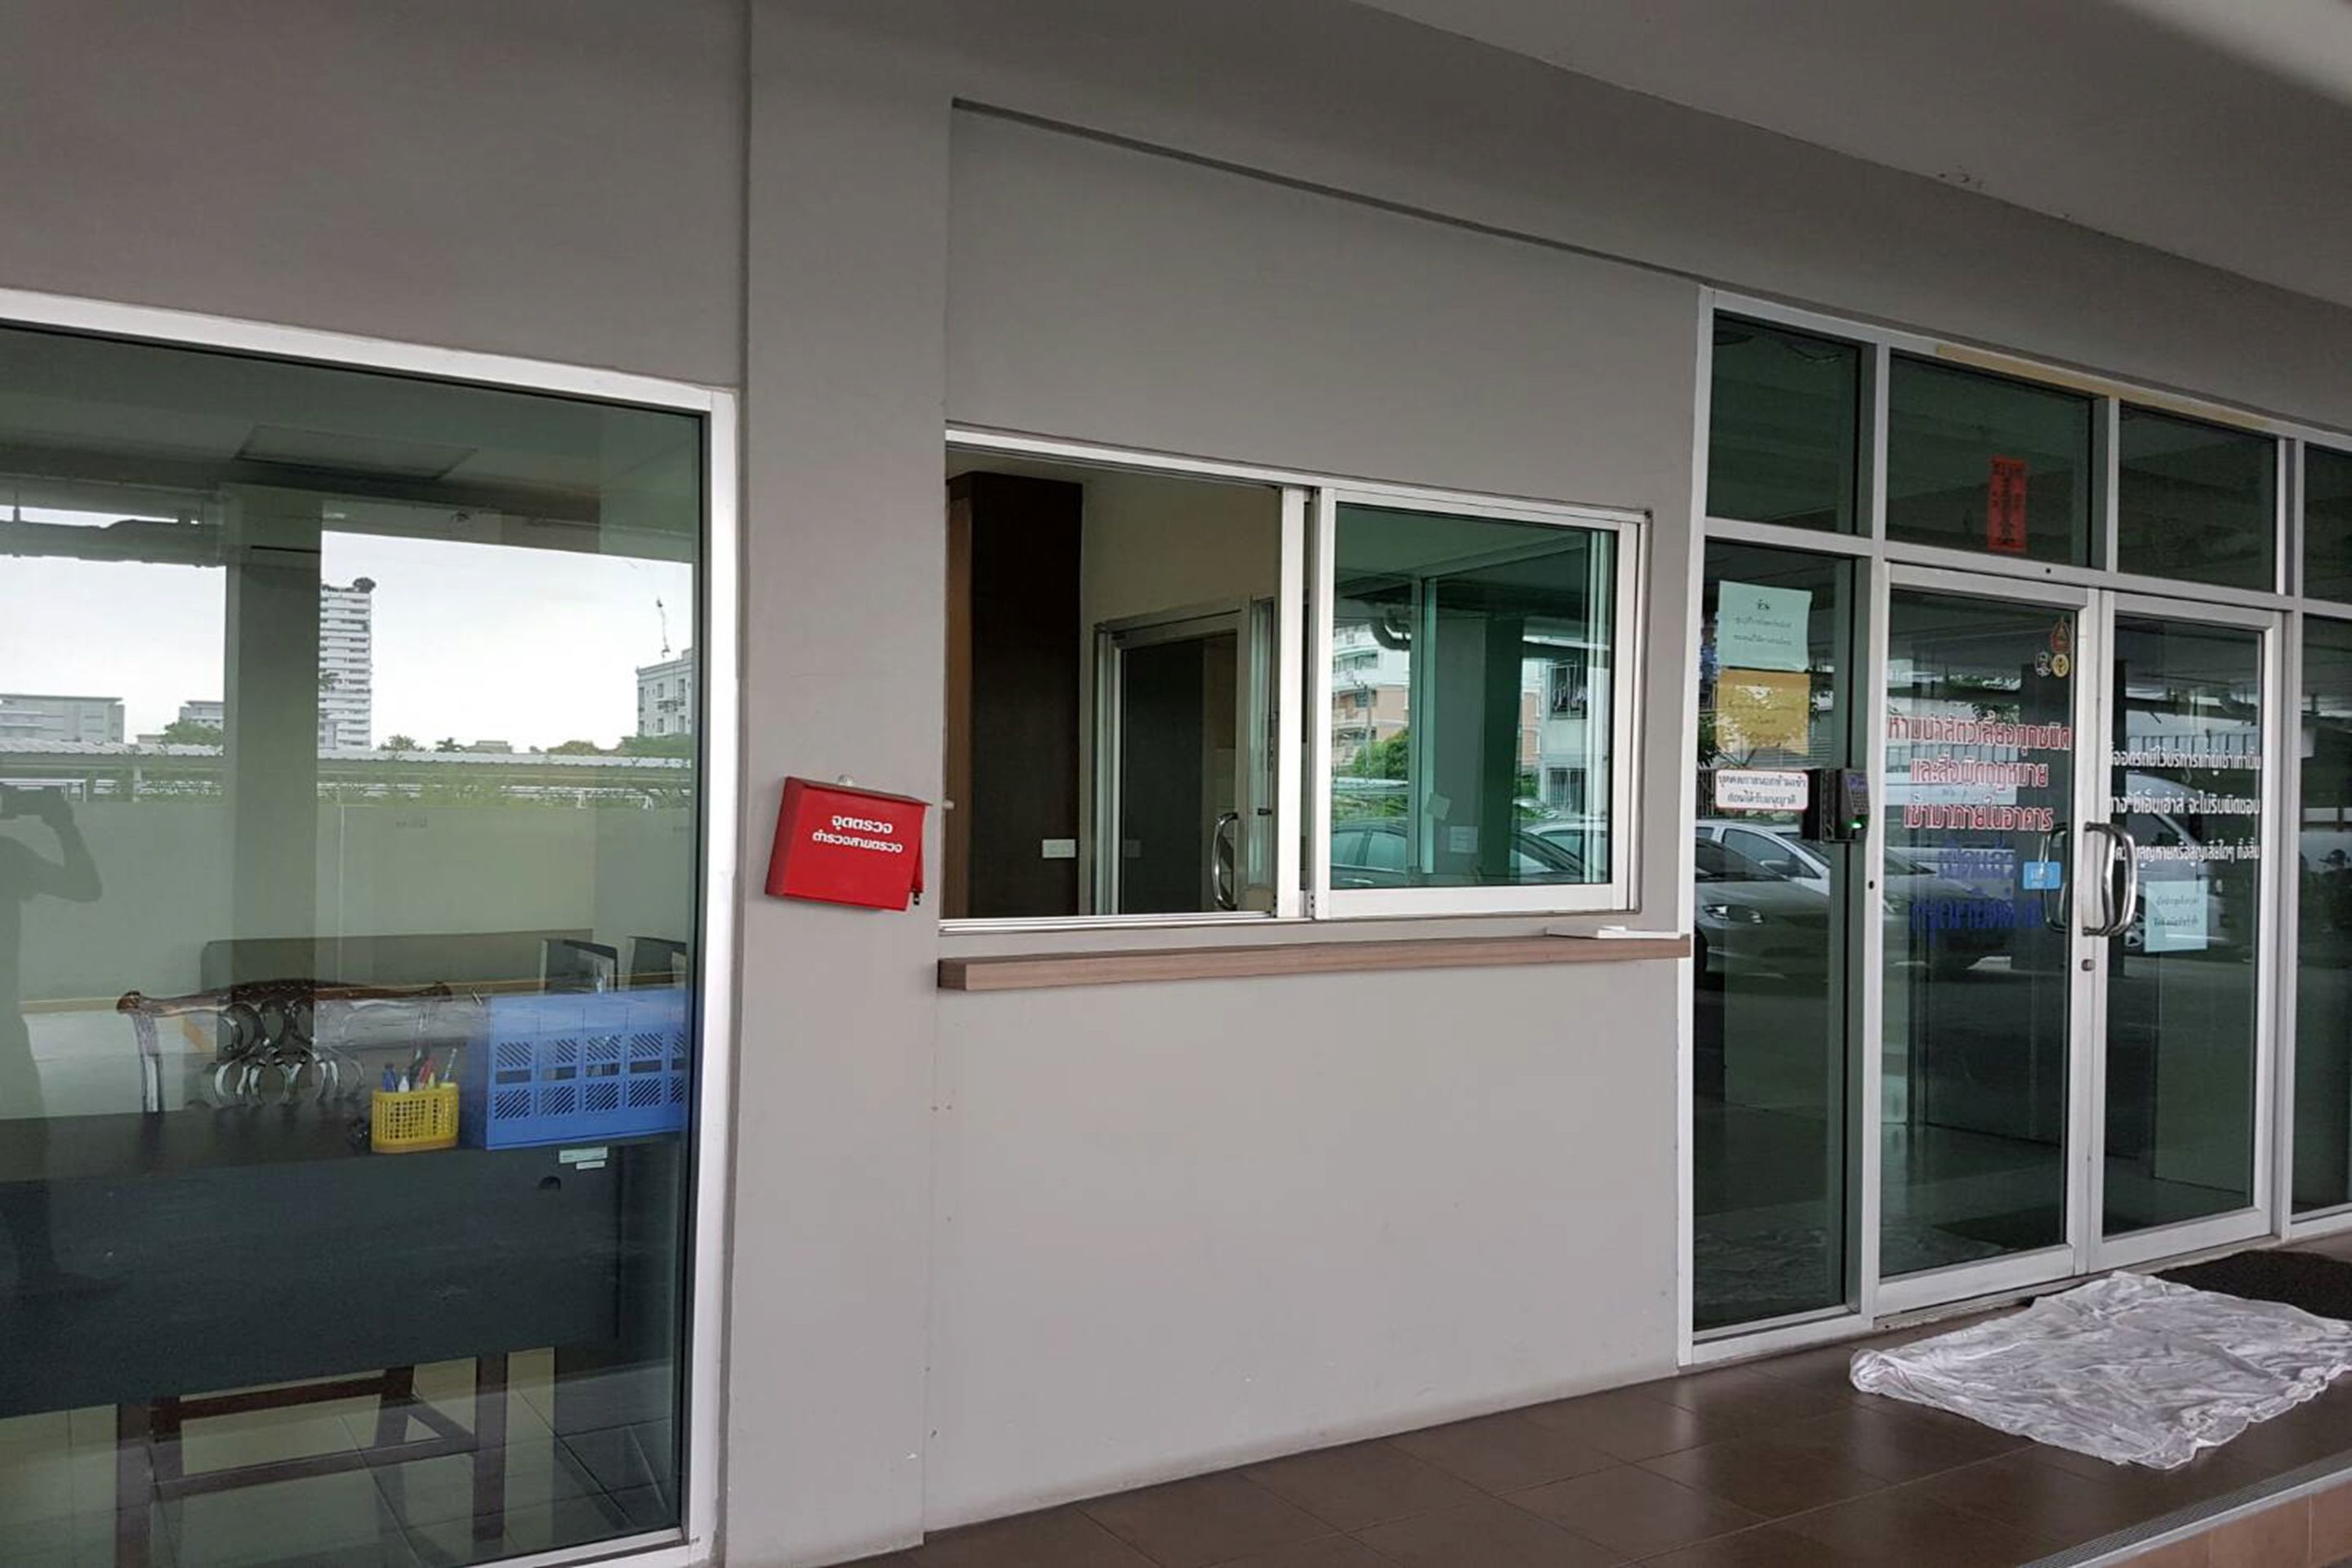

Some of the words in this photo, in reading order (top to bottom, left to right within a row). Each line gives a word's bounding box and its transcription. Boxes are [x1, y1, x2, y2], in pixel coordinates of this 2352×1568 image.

[1887, 707, 2071, 756] ห้ามนำสัตว์เลี้ยงทุกชนิด
[1910, 753, 2048, 793] และสิ่งผิดกฎหมาย
[2109, 742, 2261, 776] จอดรถมีไว้บริการแก่ผู้เช่าเท่านั้น
[831, 815, 893, 834] จุดตรวจ
[1904, 793, 2054, 831] เข้ามาภายในอาคาร
[2116, 837, 2235, 867] คสูญหายหรือสูญเสียใดๆ
